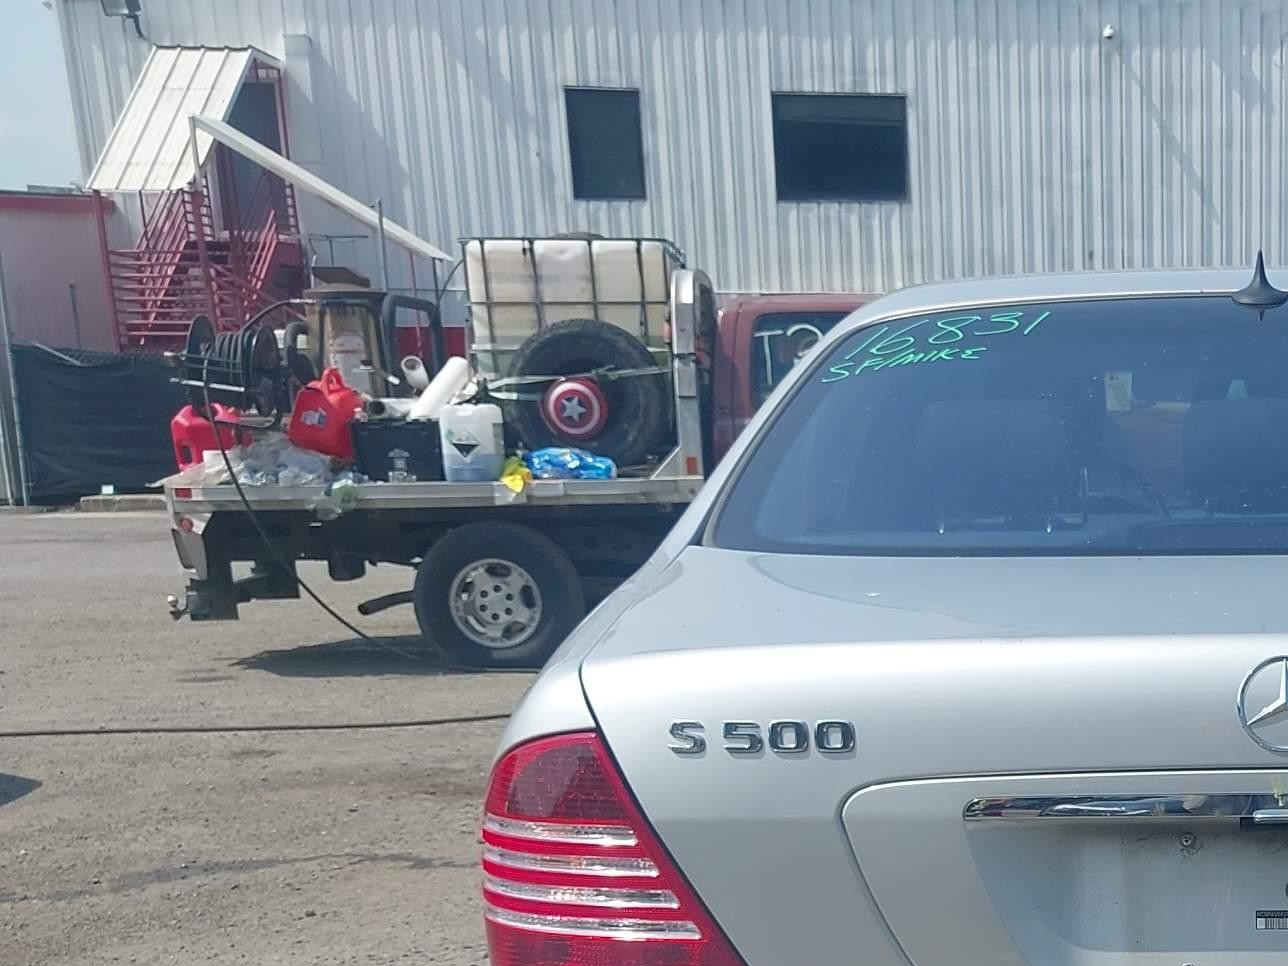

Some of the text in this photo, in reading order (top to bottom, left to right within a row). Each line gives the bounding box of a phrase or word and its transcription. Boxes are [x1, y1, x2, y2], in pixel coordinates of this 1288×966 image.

[844, 311, 1050, 360] 16831
[668, 720, 856, 753] S 500
